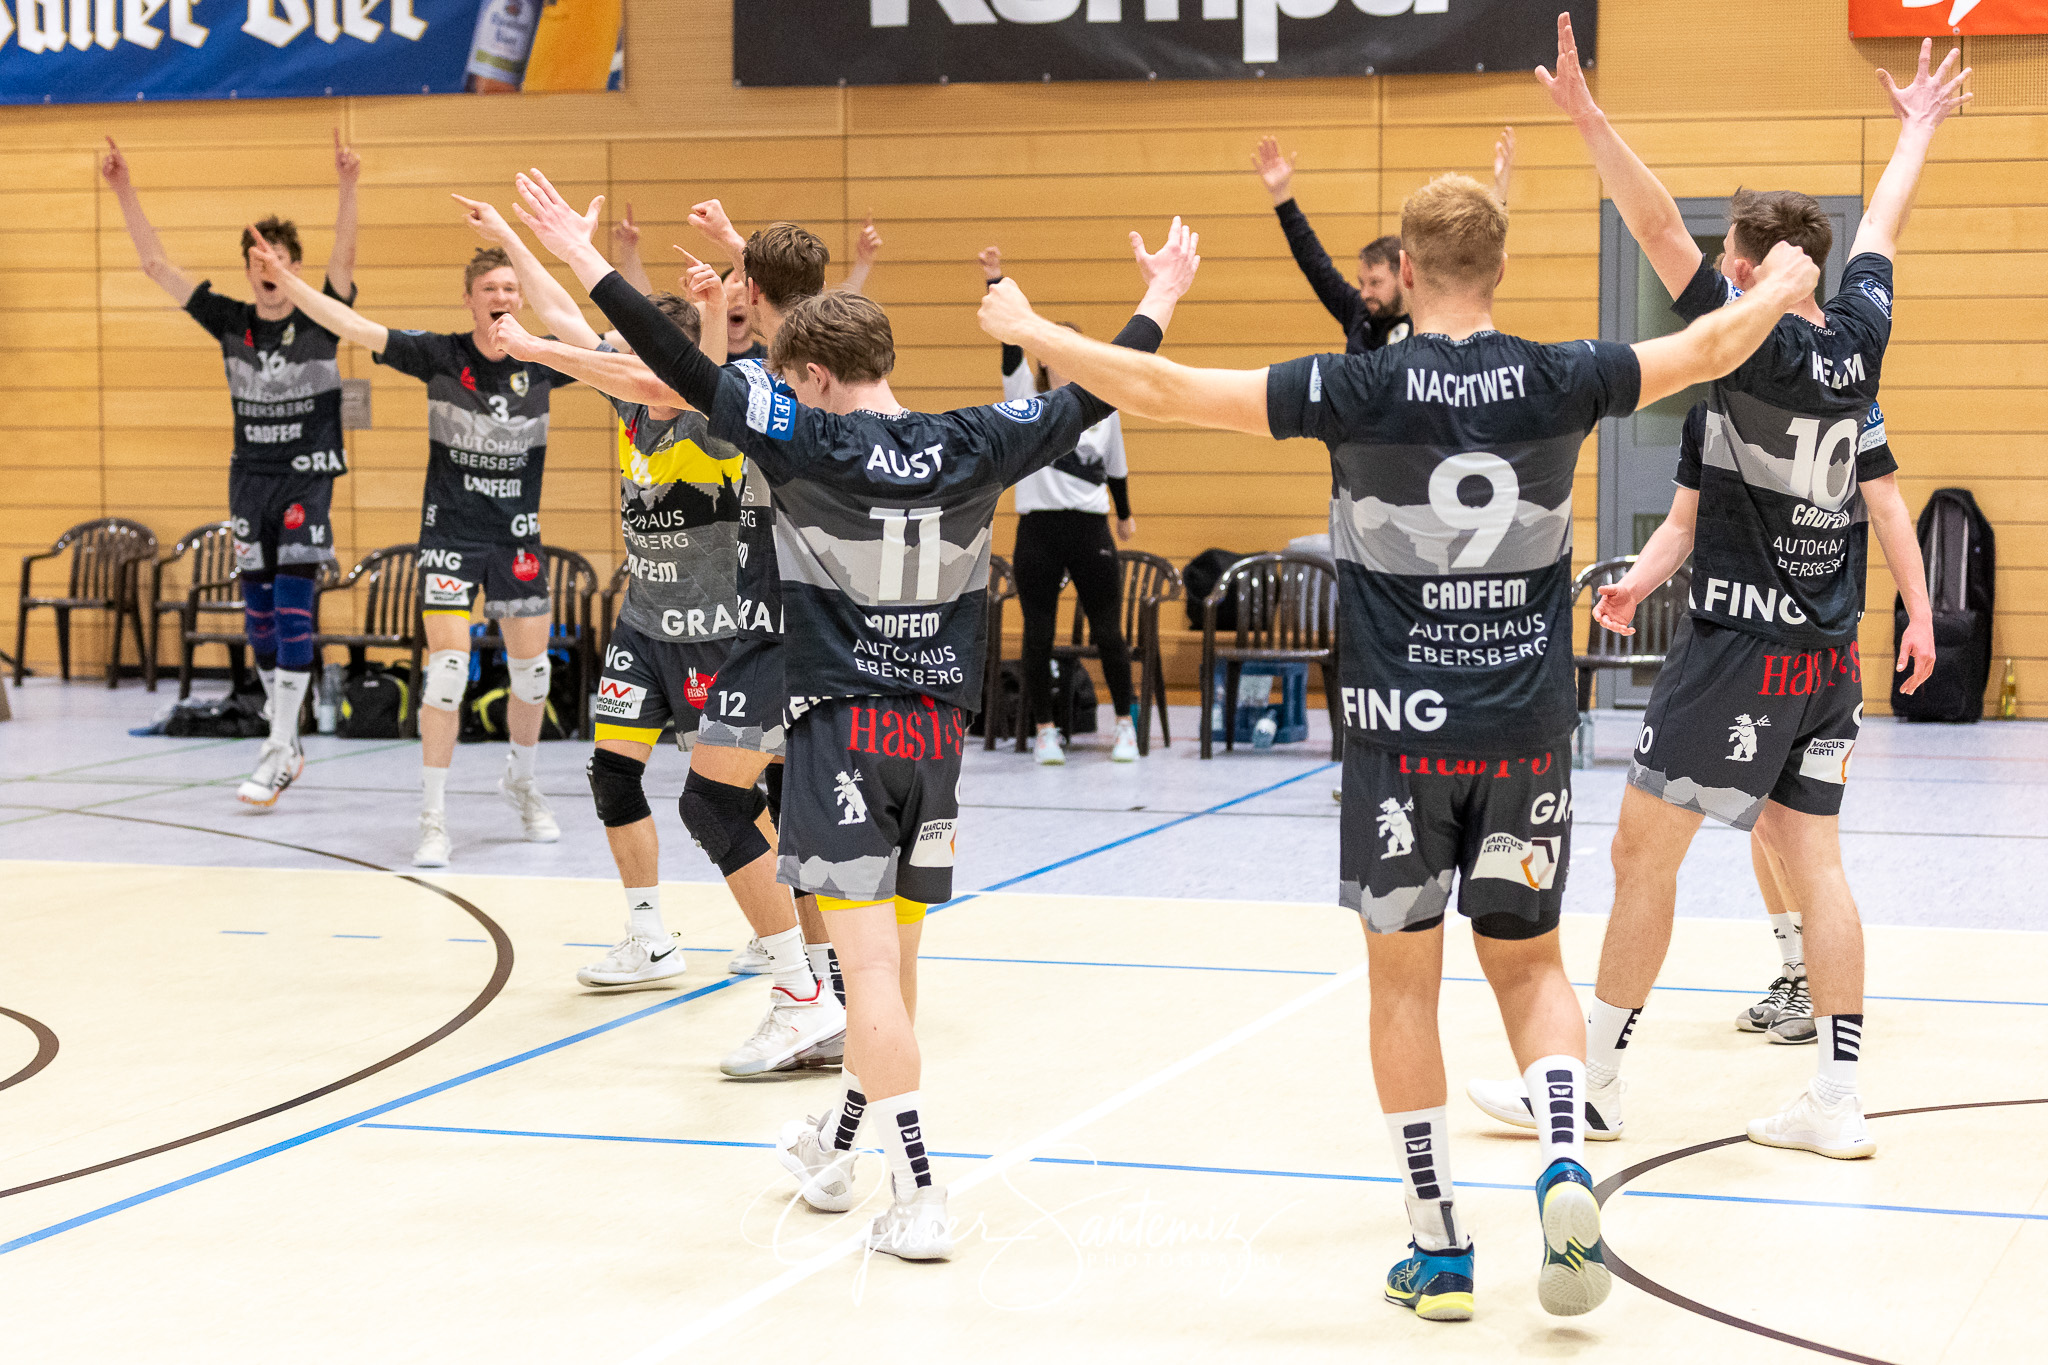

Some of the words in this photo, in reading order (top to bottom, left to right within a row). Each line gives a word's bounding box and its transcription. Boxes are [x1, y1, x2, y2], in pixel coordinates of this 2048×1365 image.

[1406, 364, 1526, 408] NACHTWEY
[488, 394, 510, 423] 3
[866, 443, 944, 480] AUST
[1785, 417, 1859, 513] 10
[1428, 451, 1521, 569] 9
[869, 506, 944, 600] 11
[1773, 535, 1845, 556] AUTOHA
[1422, 578, 1529, 610] CADFEM
[661, 603, 738, 637] GRA
[1408, 613, 1546, 643] AUTOHAUS
[1408, 636, 1548, 666] EBERSBERG
[718, 690, 747, 718] 12
[1341, 686, 1448, 732] FING
[919, 831, 944, 842] KERTI
[922, 821, 952, 833] MARCUS
[1483, 844, 1512, 854] ERTI
